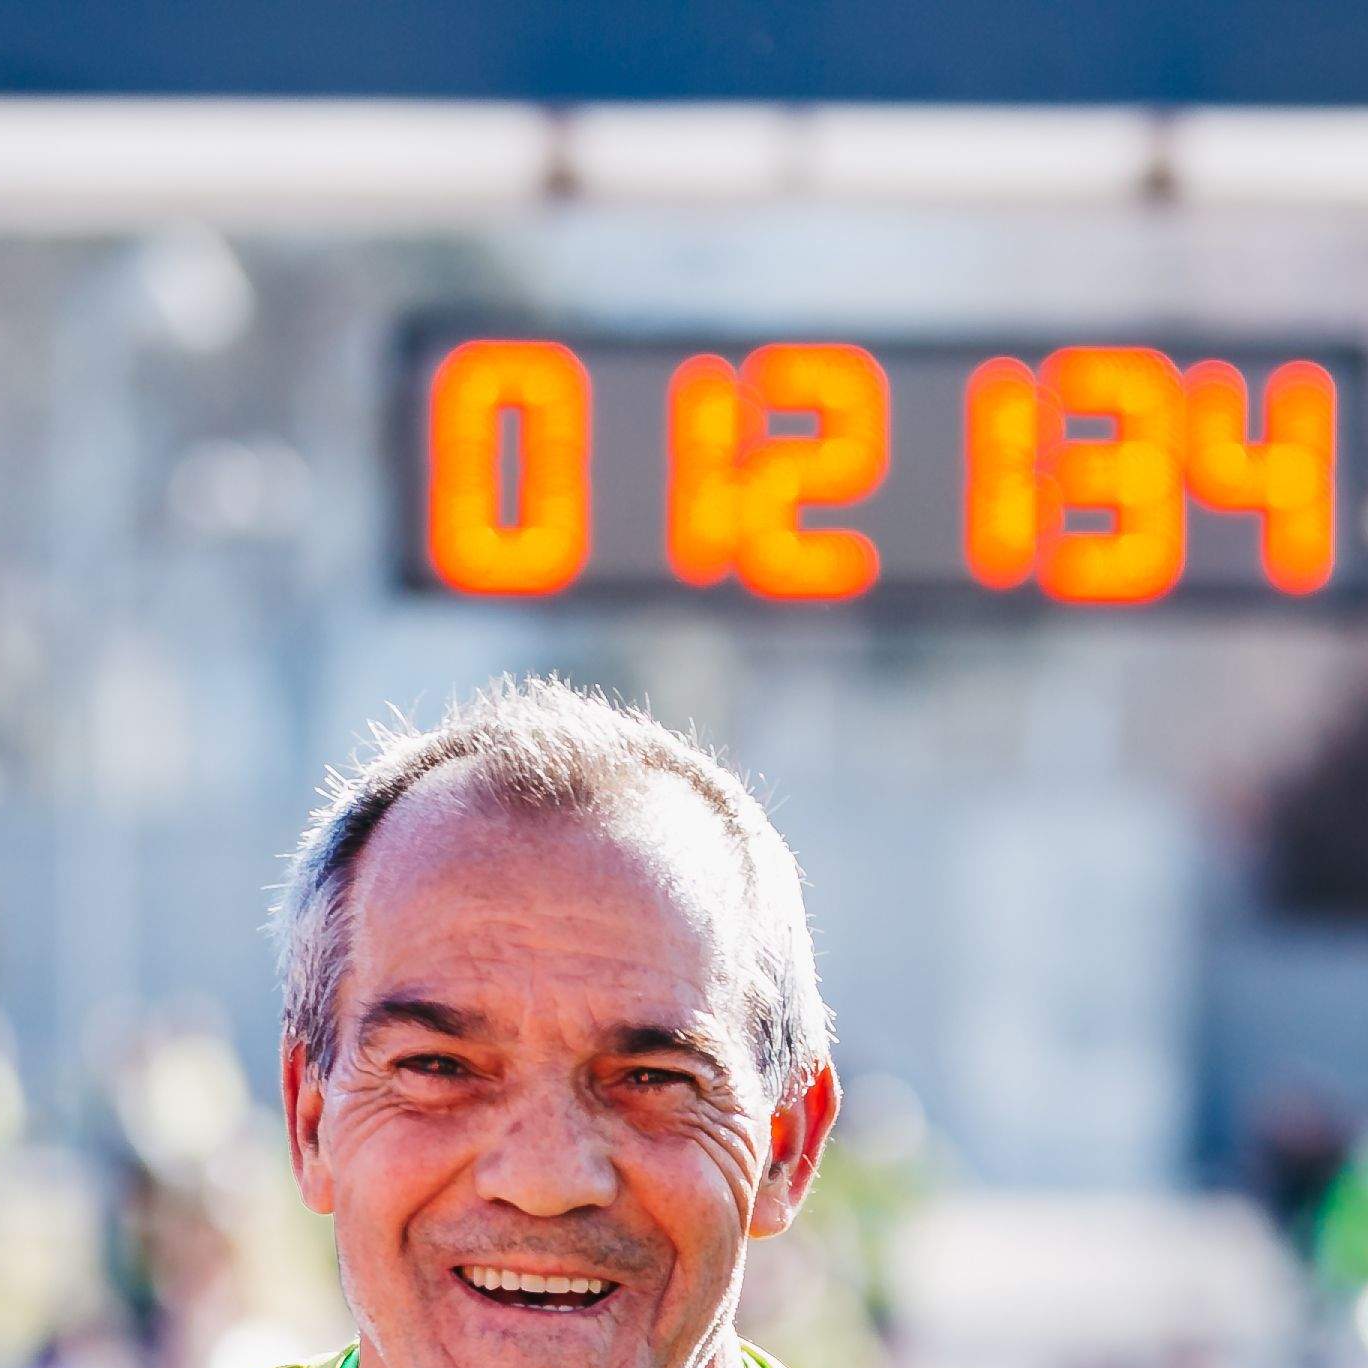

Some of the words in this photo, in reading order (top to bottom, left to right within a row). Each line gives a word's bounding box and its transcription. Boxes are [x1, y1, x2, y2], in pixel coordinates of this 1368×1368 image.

[431, 340, 592, 596] 0
[665, 344, 891, 600] 12
[964, 345, 1336, 603] 134
